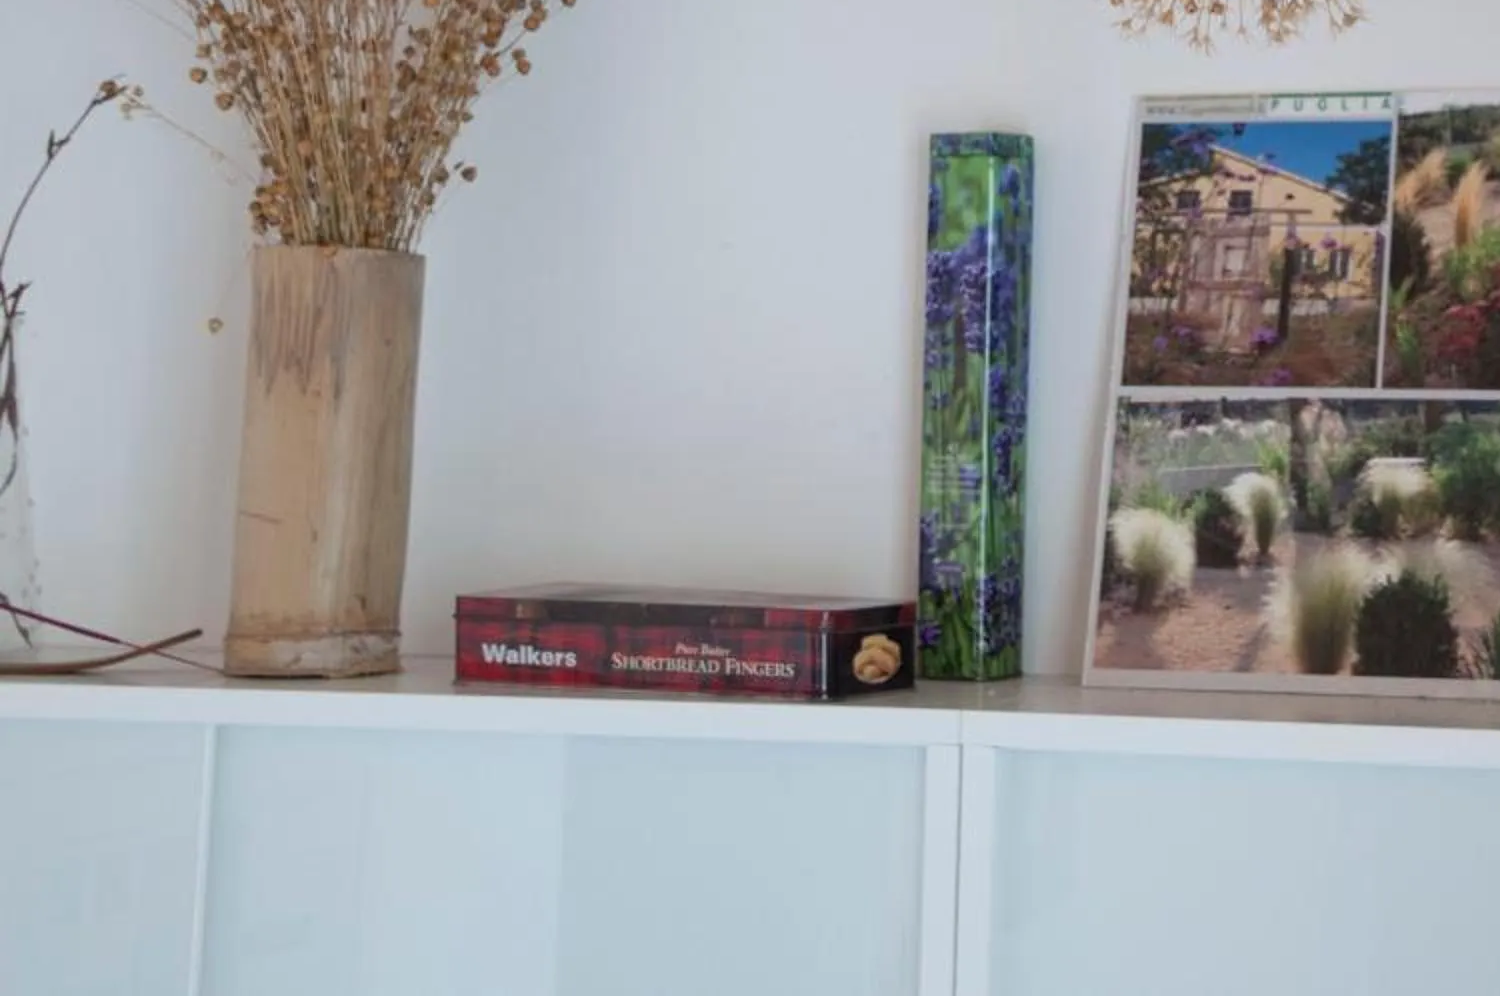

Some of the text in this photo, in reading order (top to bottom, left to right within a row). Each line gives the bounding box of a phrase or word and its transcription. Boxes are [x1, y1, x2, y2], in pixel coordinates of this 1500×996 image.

[1271, 96, 1391, 112] PUGLIA
[481, 642, 577, 668] Walkers
[611, 651, 796, 677] SHORTBREAD FINGERS
